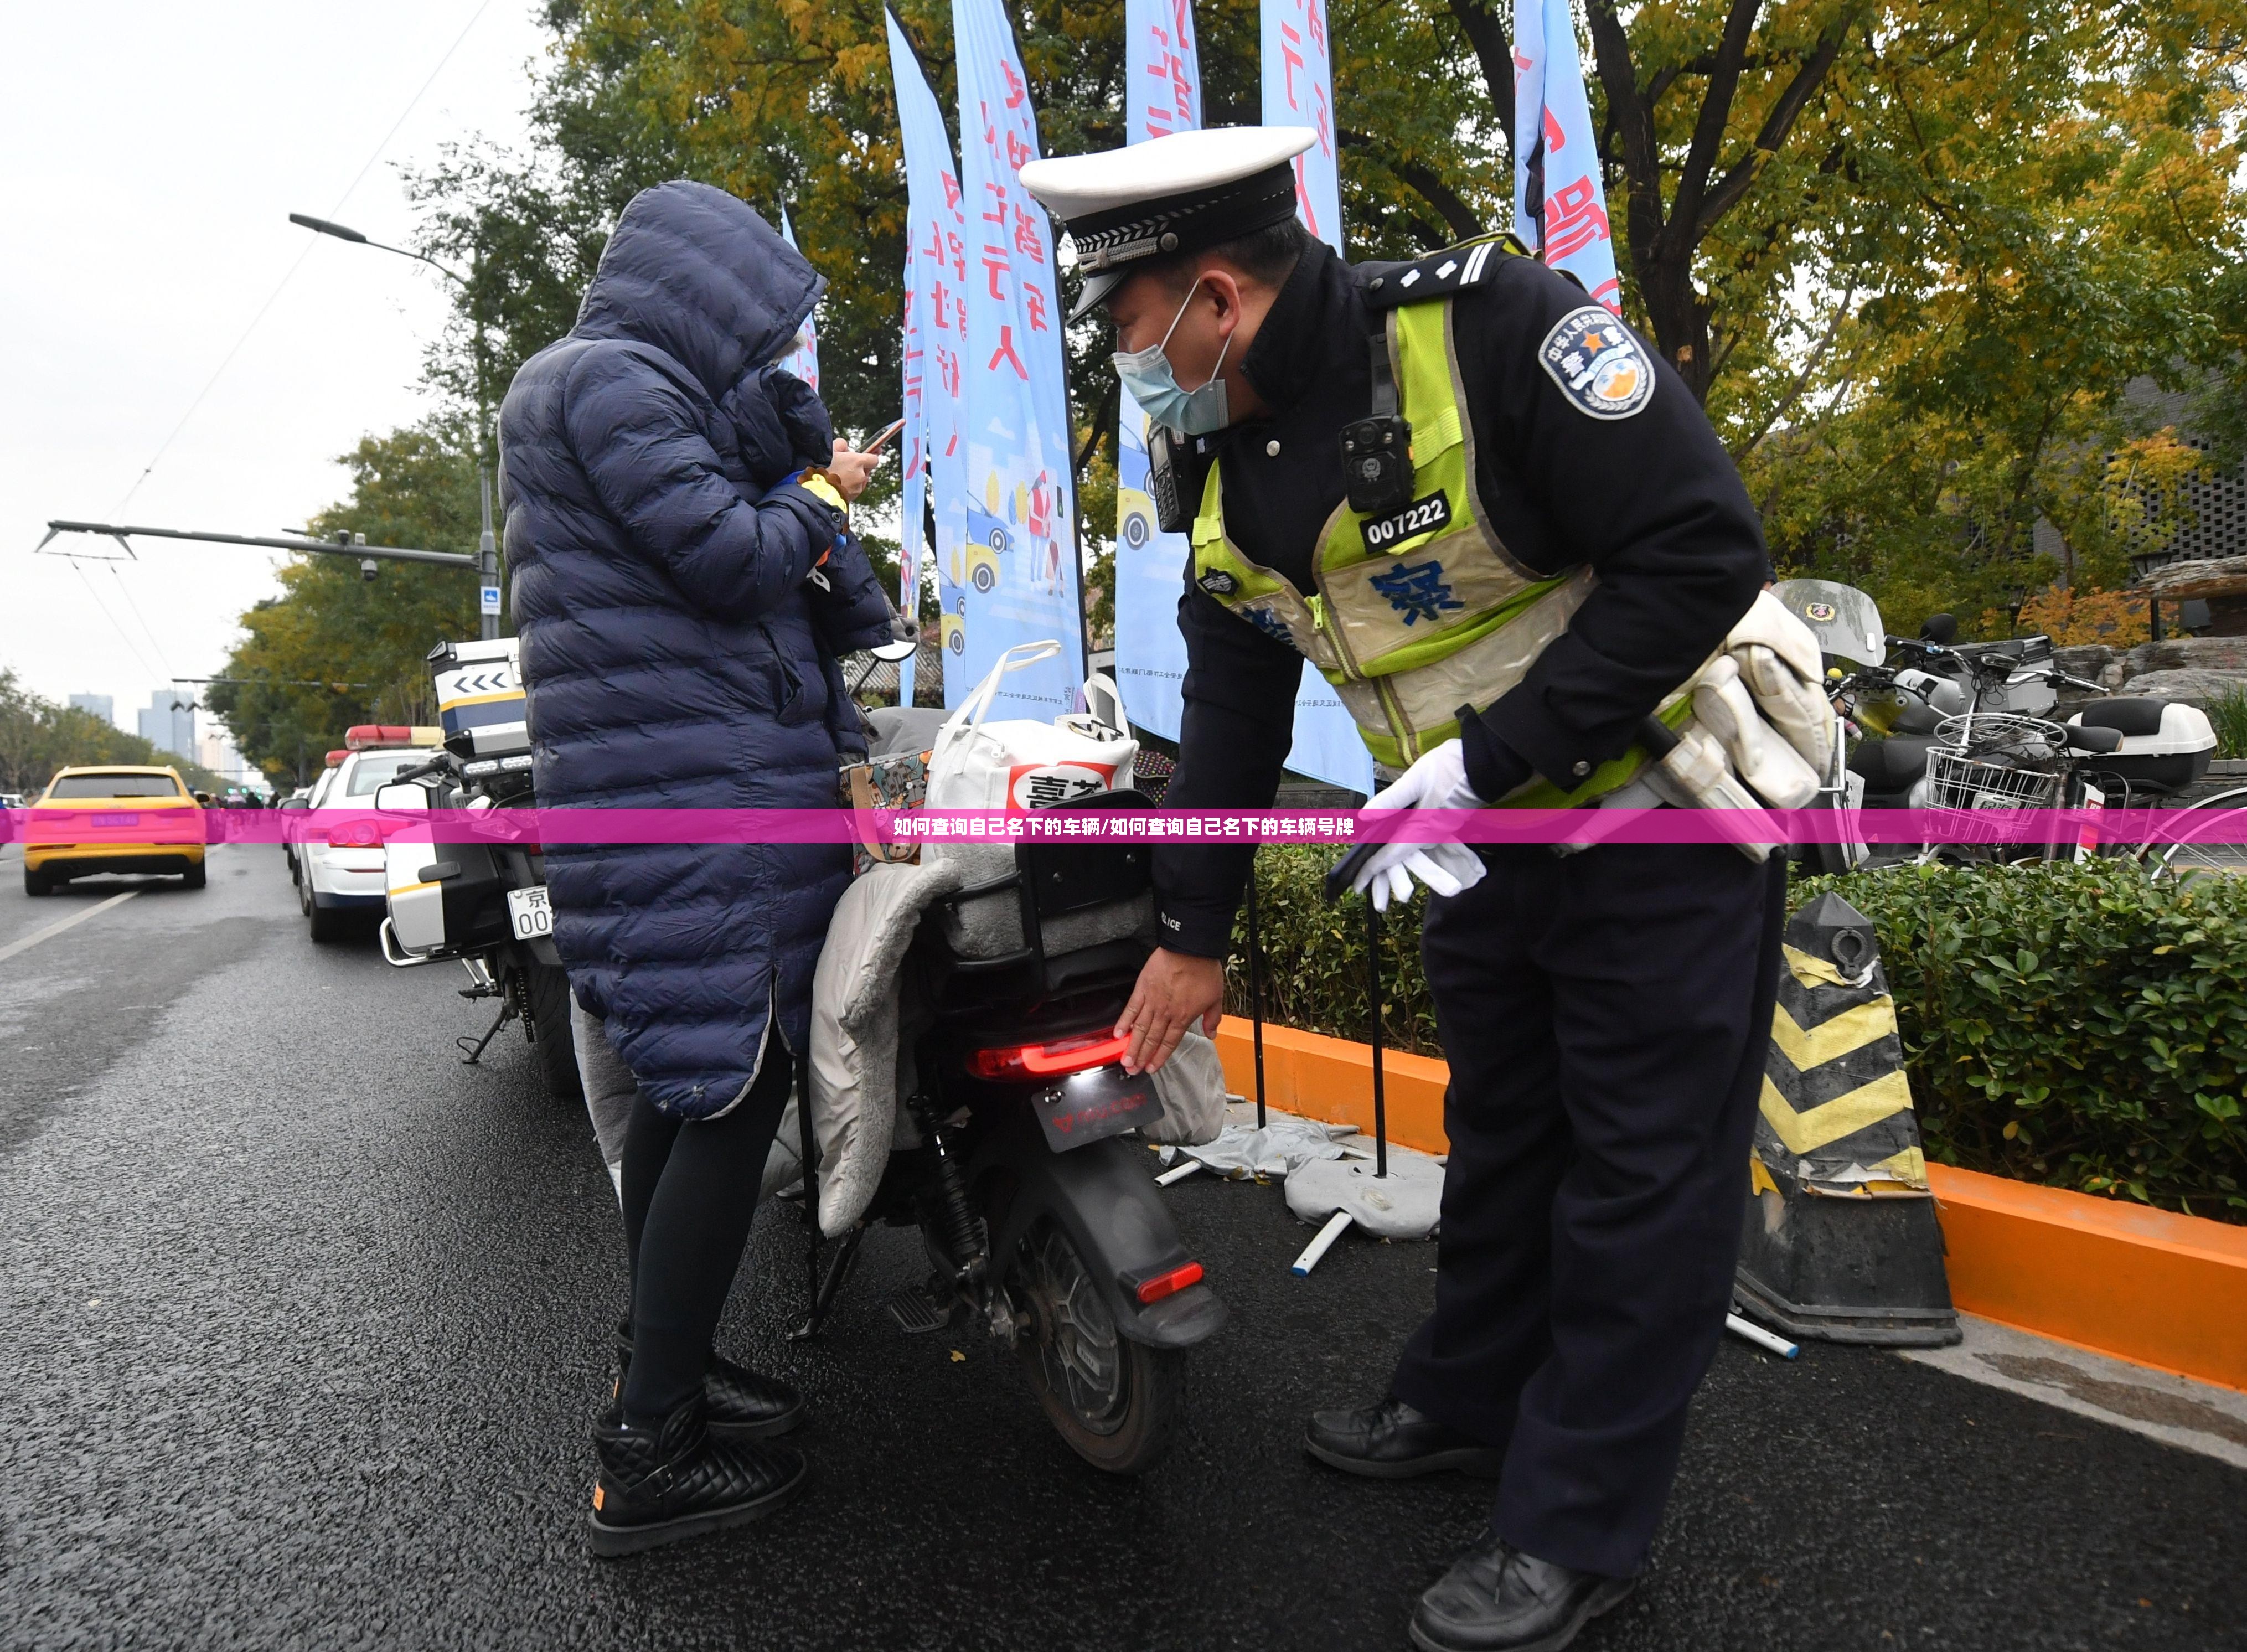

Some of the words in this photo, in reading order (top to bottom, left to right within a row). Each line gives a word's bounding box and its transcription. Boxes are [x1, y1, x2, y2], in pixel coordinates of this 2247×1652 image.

[1367, 499, 1445, 544] 007222
[526, 890, 547, 908] 京
[519, 910, 552, 935] 00
[1161, 911, 1181, 932] LICE
